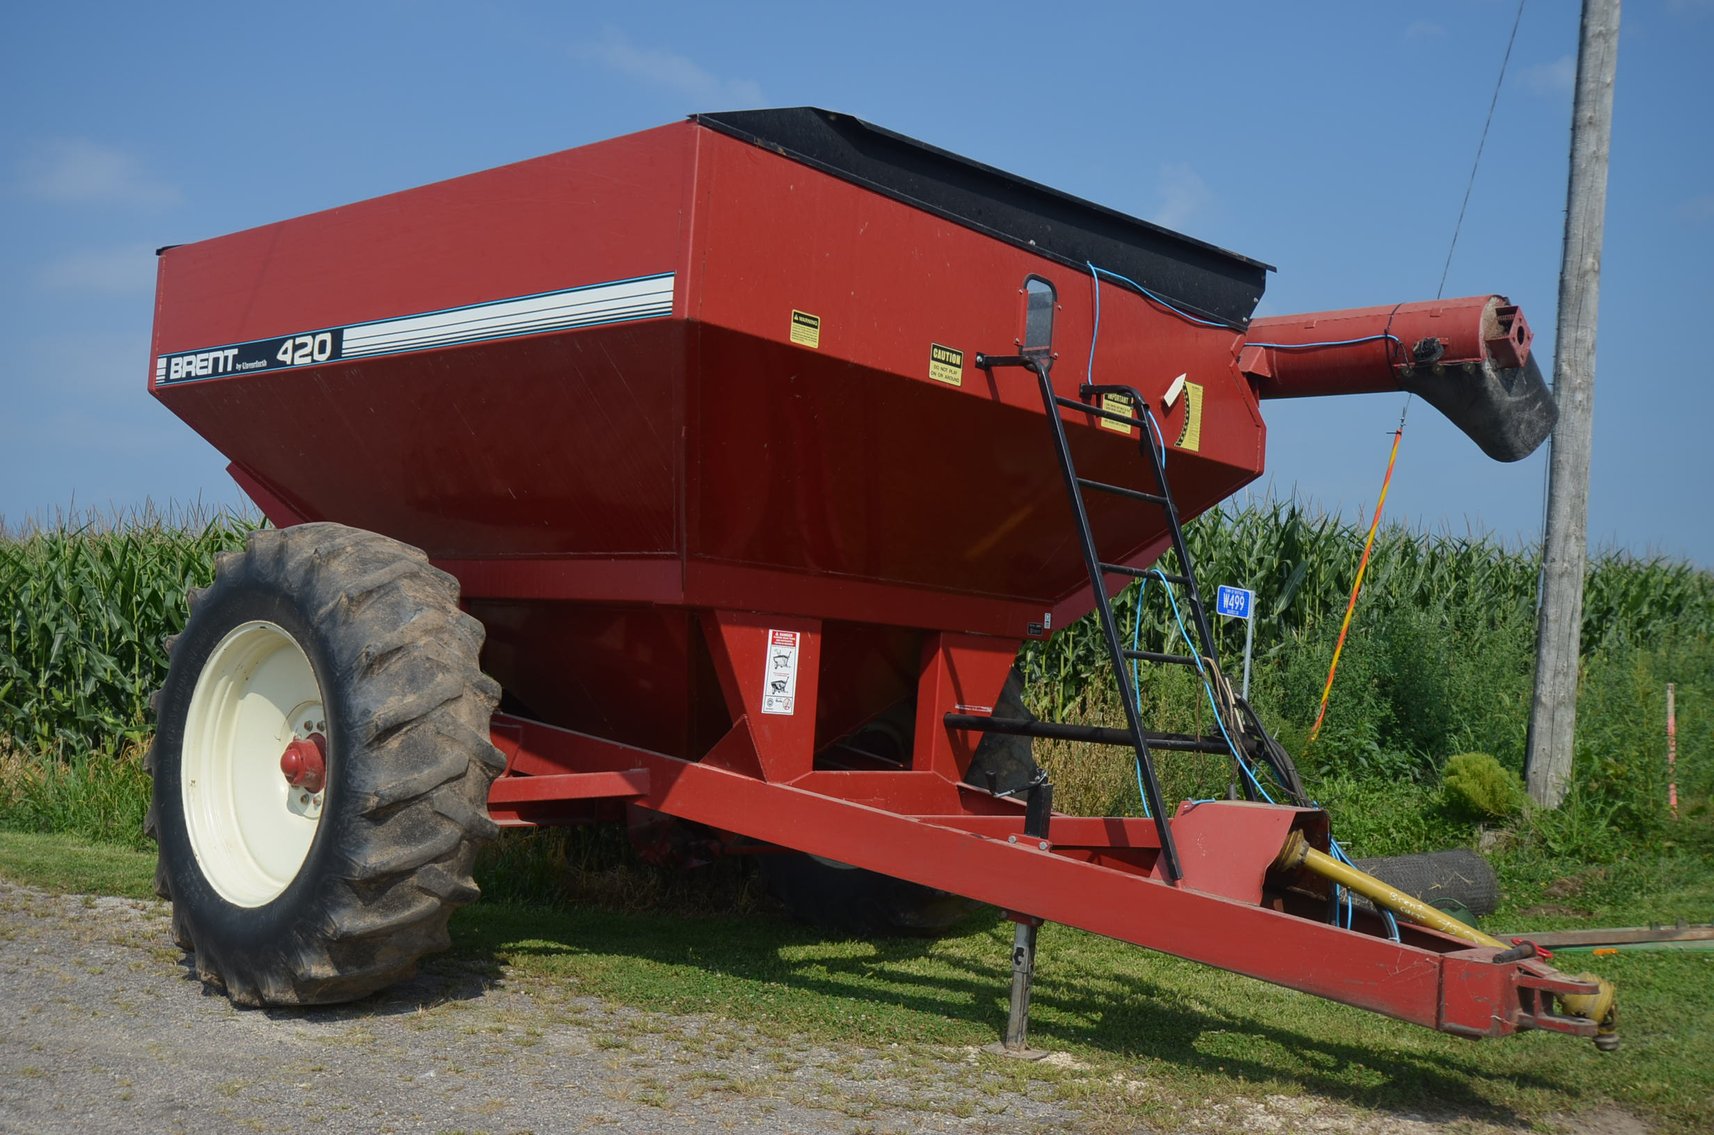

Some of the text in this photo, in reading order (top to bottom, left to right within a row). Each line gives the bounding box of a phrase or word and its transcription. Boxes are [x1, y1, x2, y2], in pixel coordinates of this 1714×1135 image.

[169, 348, 239, 380] BRENT
[276, 332, 332, 365] 420
[933, 347, 961, 365] CAUTION
[944, 374, 960, 383] AROUND
[1223, 592, 1245, 611] W499
